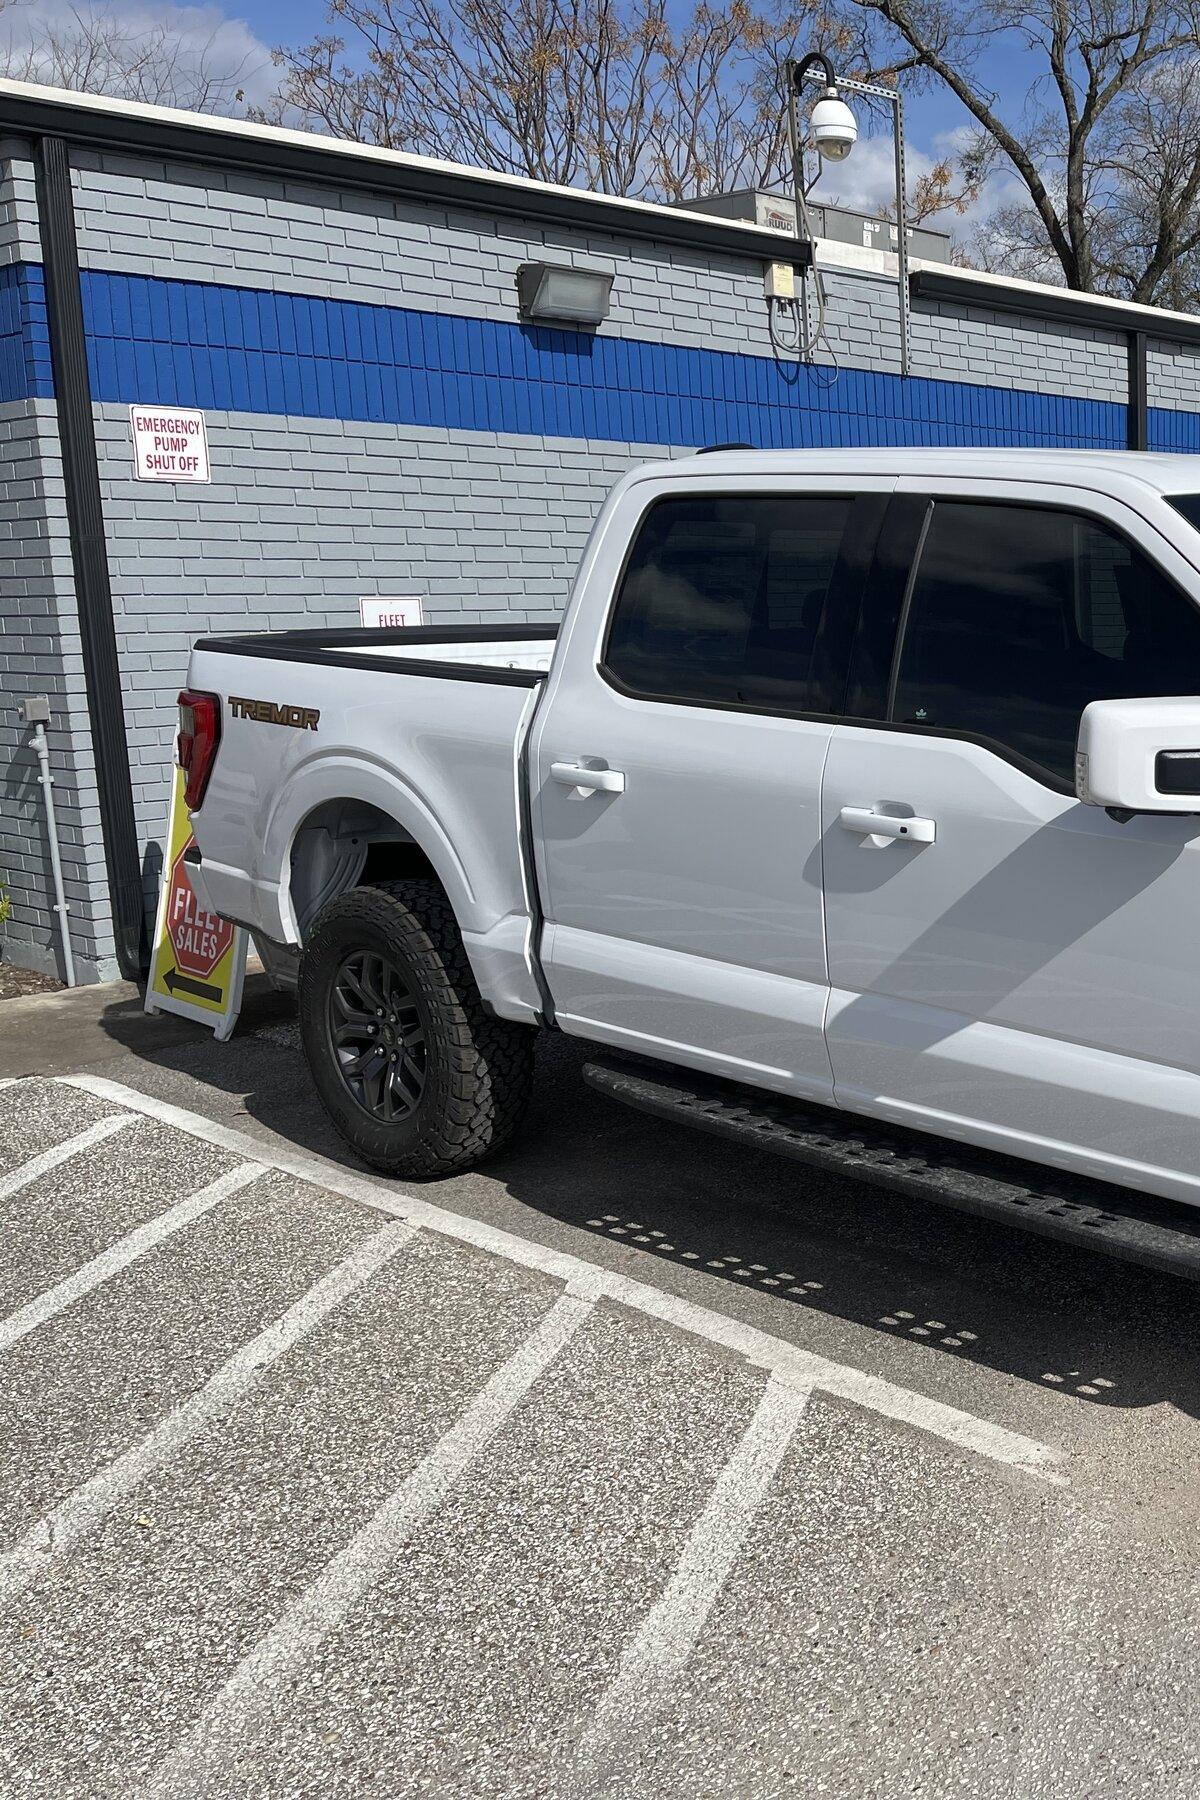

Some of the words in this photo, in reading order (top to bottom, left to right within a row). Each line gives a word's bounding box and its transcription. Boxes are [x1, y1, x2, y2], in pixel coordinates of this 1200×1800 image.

[769, 219, 793, 231] RUUD
[136, 417, 200, 435] EMERGENCY
[154, 436, 188, 452] PUMP
[146, 454, 176, 470] SHUT
[179, 456, 199, 471] OFF
[379, 614, 405, 628] FLEET
[228, 695, 320, 731] TREMOR
[176, 924, 218, 960] SALES
